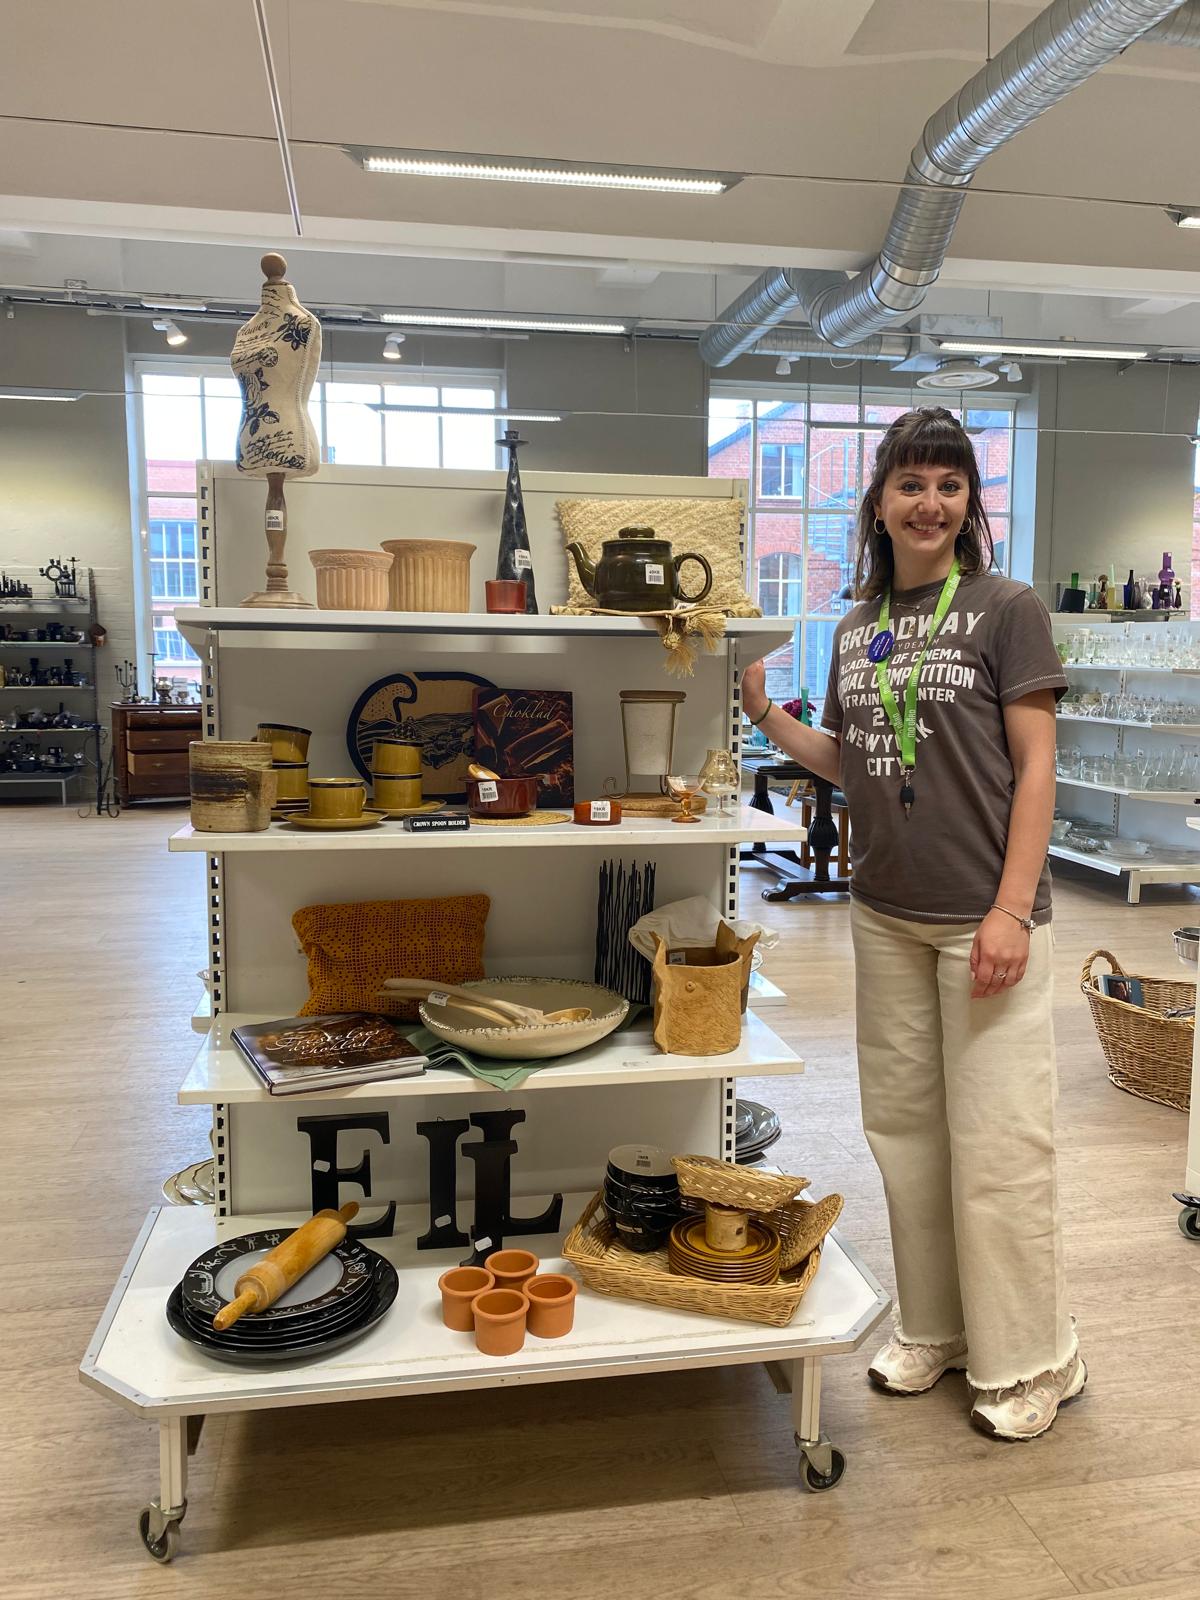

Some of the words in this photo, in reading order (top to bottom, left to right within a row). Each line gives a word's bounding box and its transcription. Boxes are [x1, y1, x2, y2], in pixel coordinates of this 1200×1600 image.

[891, 652, 910, 665] OF
[911, 648, 961, 663] CNEMA
[870, 663, 976, 690] CMPTITION
[494, 697, 561, 720] Choklad
[845, 690, 900, 708] TRAING
[903, 687, 956, 703] NTER
